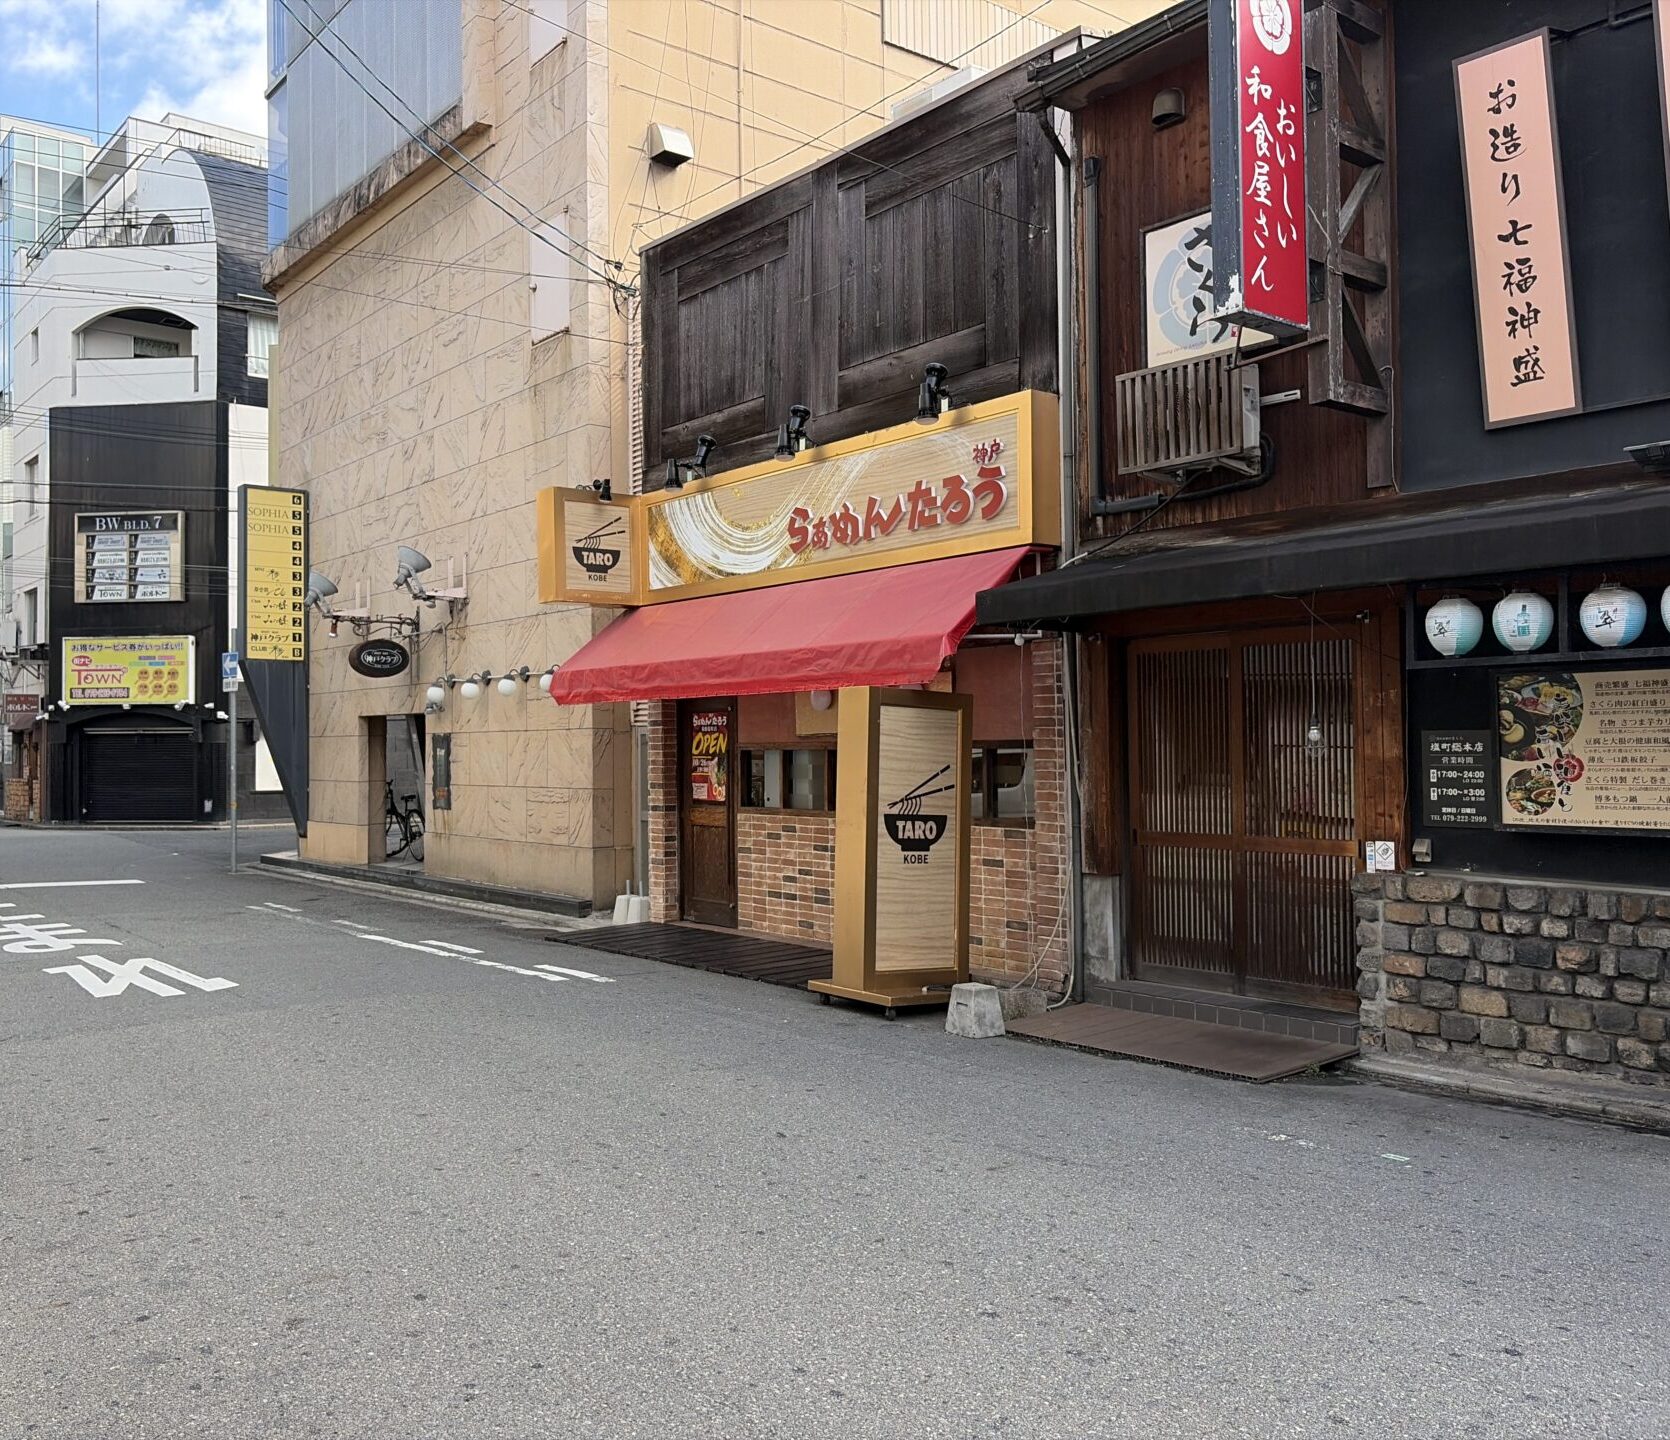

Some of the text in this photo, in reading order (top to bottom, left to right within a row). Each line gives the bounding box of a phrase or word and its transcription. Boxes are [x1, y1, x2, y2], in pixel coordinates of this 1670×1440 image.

[1245, 65, 1274, 291] 和食屋さん
[1276, 98, 1297, 248] おいしい
[1487, 79, 1546, 387] お造り七福神盛
[972, 438, 1004, 464] 神戸
[248, 506, 289, 519] SOPHIA
[787, 465, 1008, 554] らぁめんたろう
[95, 516, 162, 531] BW BLD. 7
[248, 522, 289, 535] SOPHIA
[582, 552, 613, 566] TARO
[588, 574, 608, 582] KOBE
[251, 633, 290, 642] 神戸クラブ
[71, 668, 123, 686] TOWN
[1600, 719, 1616, 727] 名物
[692, 731, 728, 755] OPEN
[895, 820, 937, 840] TARO
[903, 854, 929, 864] KOBE
